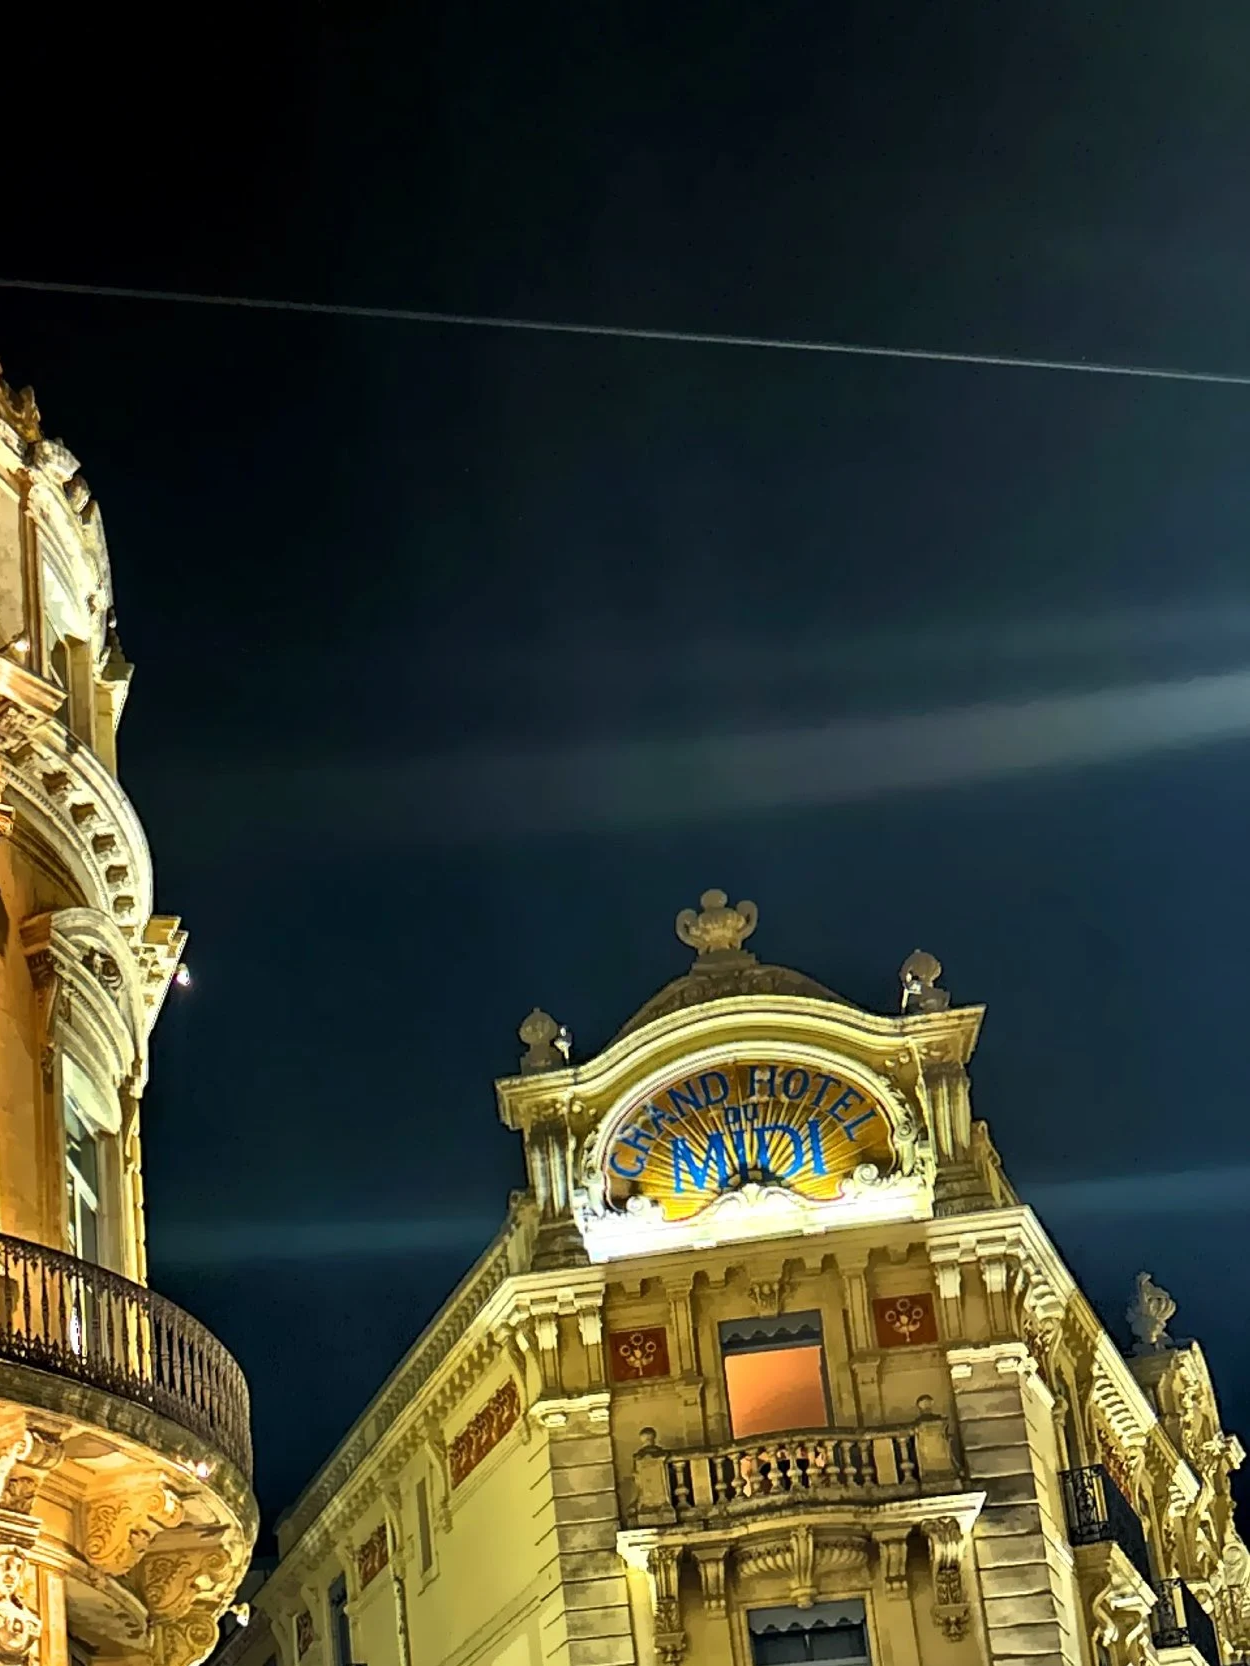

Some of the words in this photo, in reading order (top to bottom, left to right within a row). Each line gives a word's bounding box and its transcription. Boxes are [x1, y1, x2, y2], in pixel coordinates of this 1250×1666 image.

[724, 1103, 758, 1125] DU
[749, 1066, 878, 1142] HOTEL
[671, 1119, 828, 1193] MIDI
